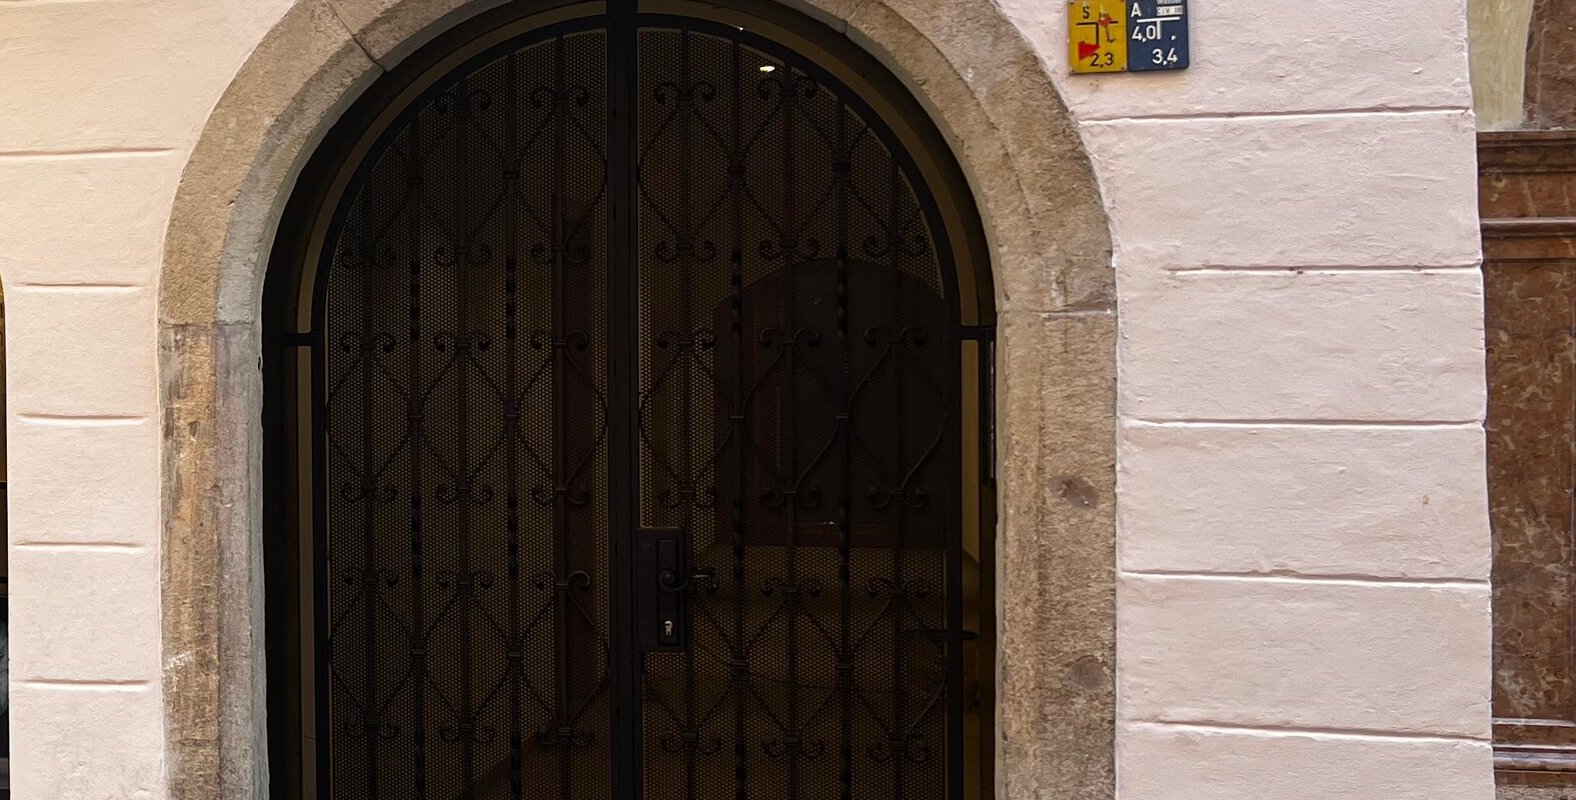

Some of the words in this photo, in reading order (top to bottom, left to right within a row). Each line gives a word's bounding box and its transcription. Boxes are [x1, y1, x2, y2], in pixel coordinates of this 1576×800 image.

[1082, 6, 1090, 19] S
[1130, 2, 1142, 17] A
[1090, 52, 1114, 68] 2,3
[1152, 48, 1178, 66] 3,4
